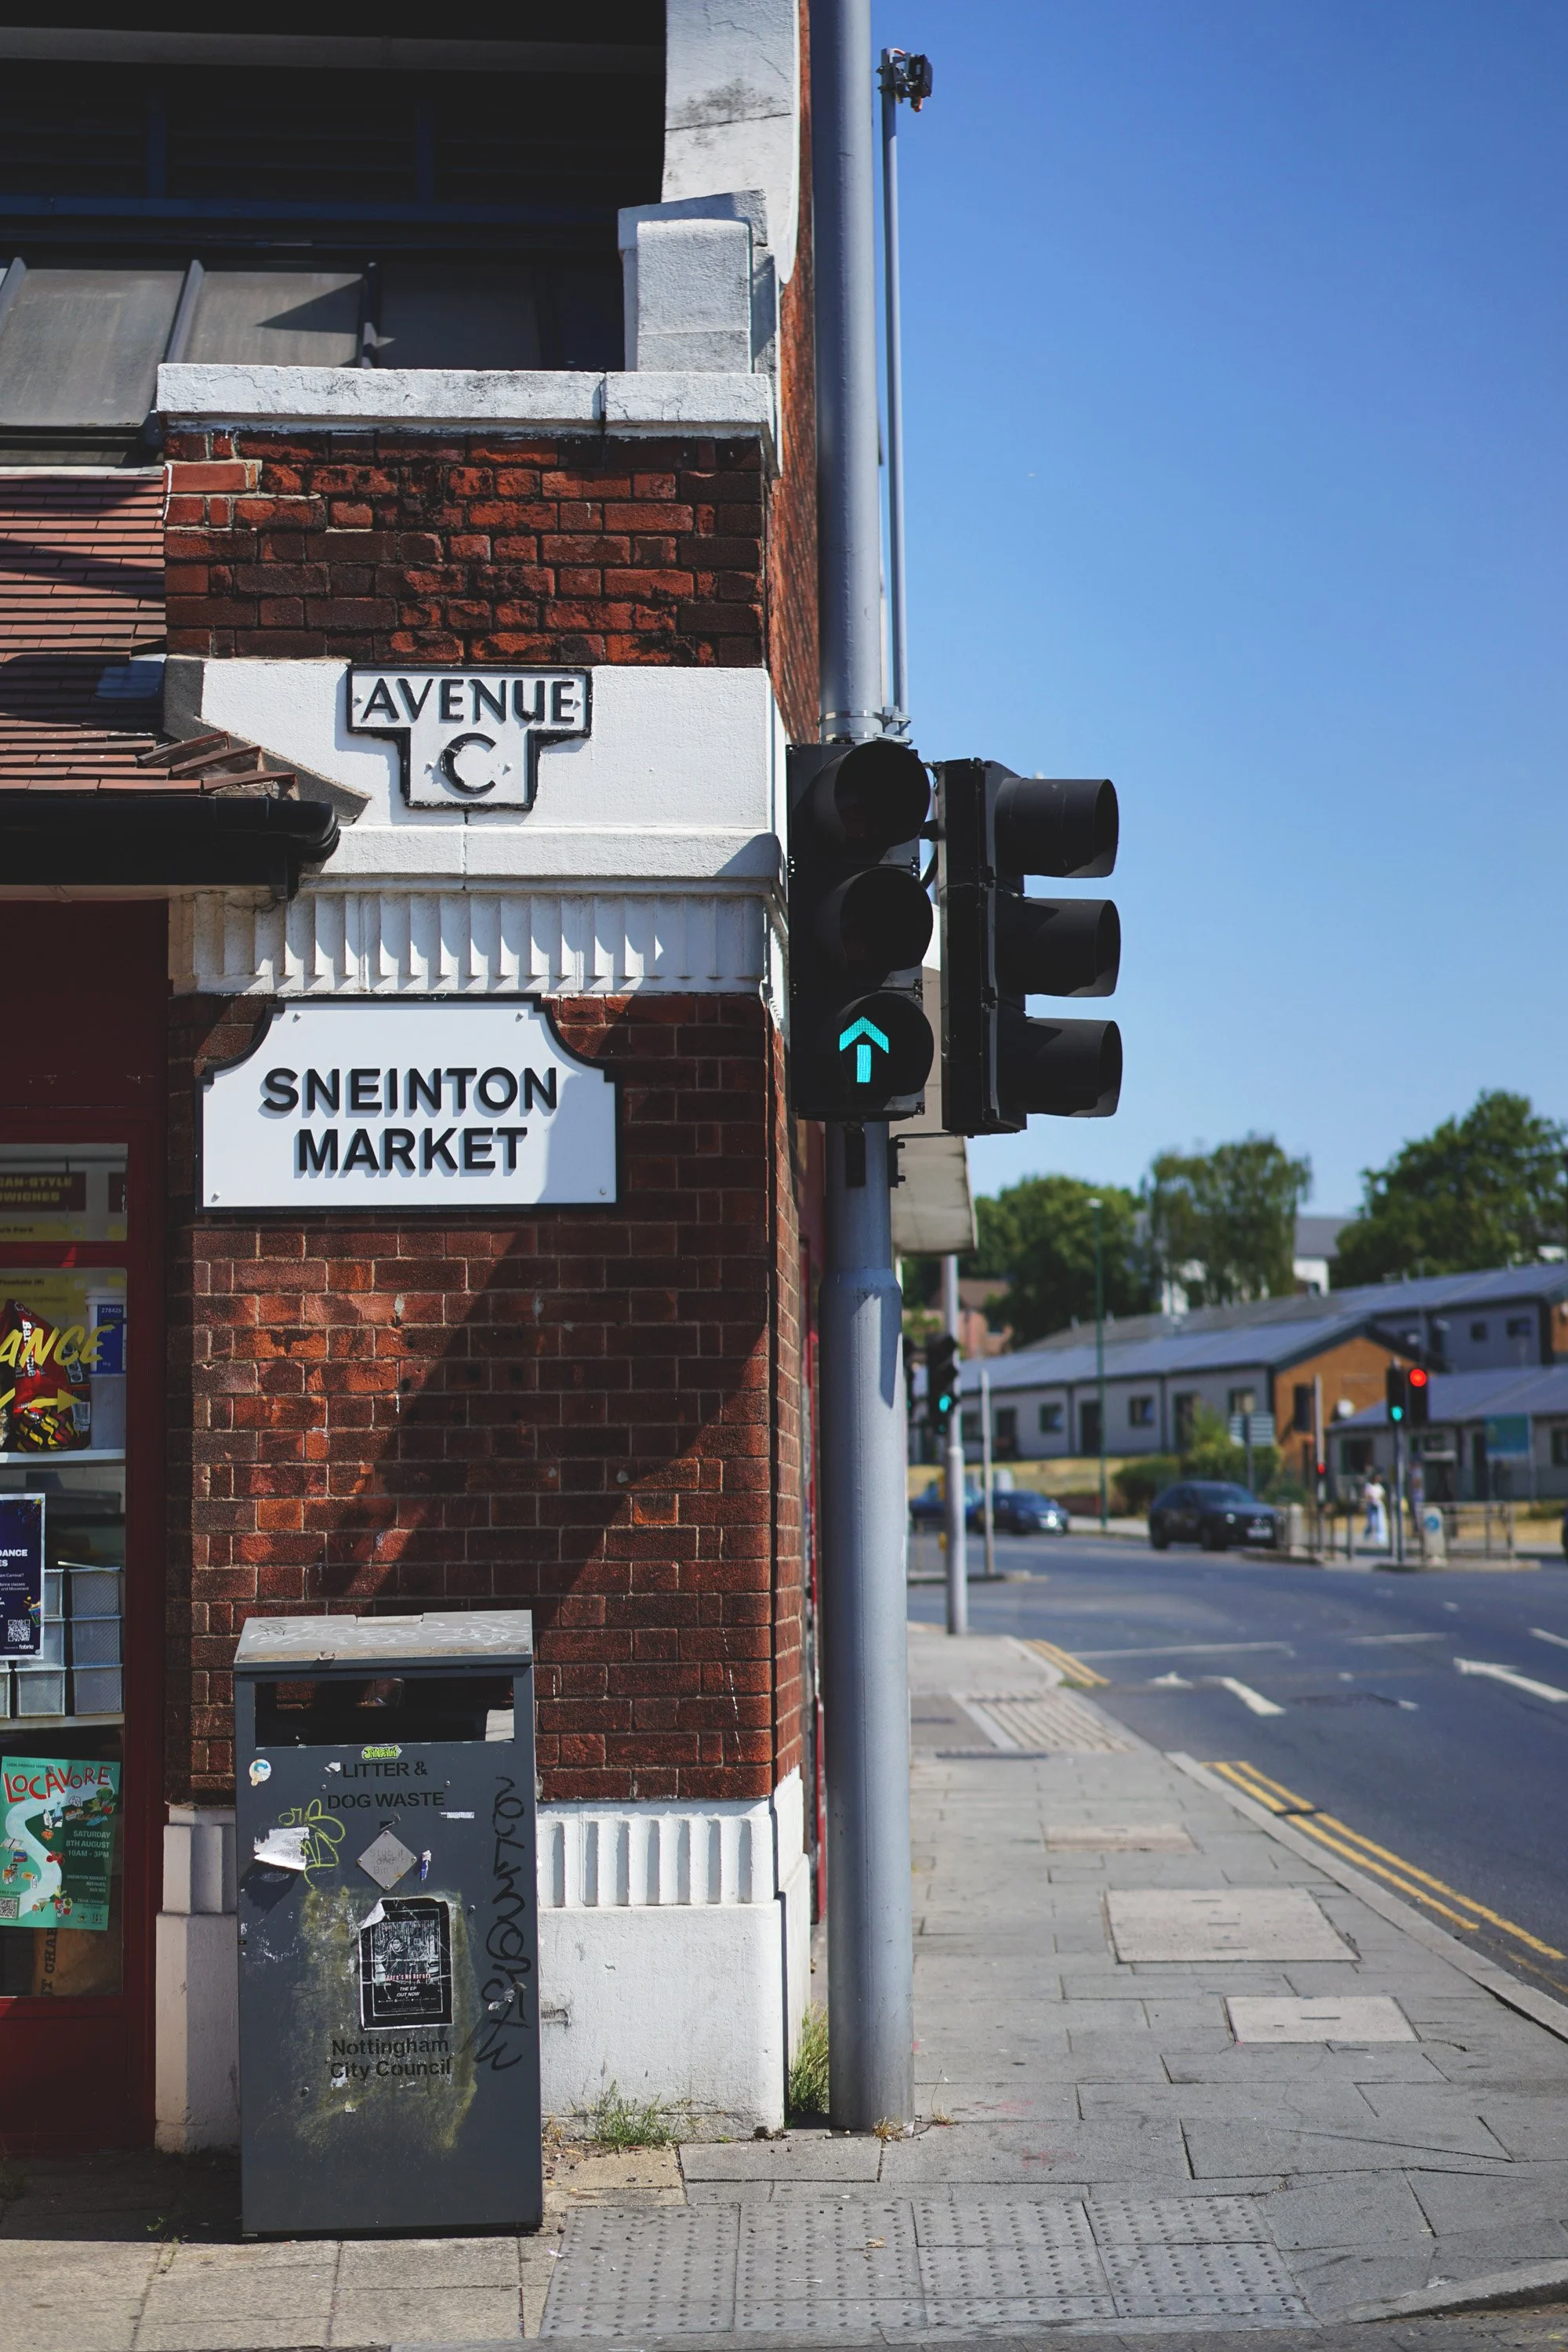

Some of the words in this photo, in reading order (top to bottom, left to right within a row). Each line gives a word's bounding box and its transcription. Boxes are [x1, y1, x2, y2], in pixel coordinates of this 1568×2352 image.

[361, 677, 575, 722] AVENUE
[440, 732, 496, 794] C
[262, 1066, 557, 1112] SNEINTON
[298, 1127, 528, 1172] MARKET
[343, 1762, 409, 1778] LITTER
[414, 1760, 428, 1776] &
[3, 1766, 113, 1804] LOCAVORE
[328, 1793, 371, 1809] DOG
[375, 1791, 445, 1808] WASTE
[73, 1830, 111, 1838] SATURDAY
[82, 1840, 111, 1849] AUGUST
[332, 2038, 449, 2058] Nottingham
[330, 2062, 370, 2082] City
[376, 2058, 452, 2077] Council
